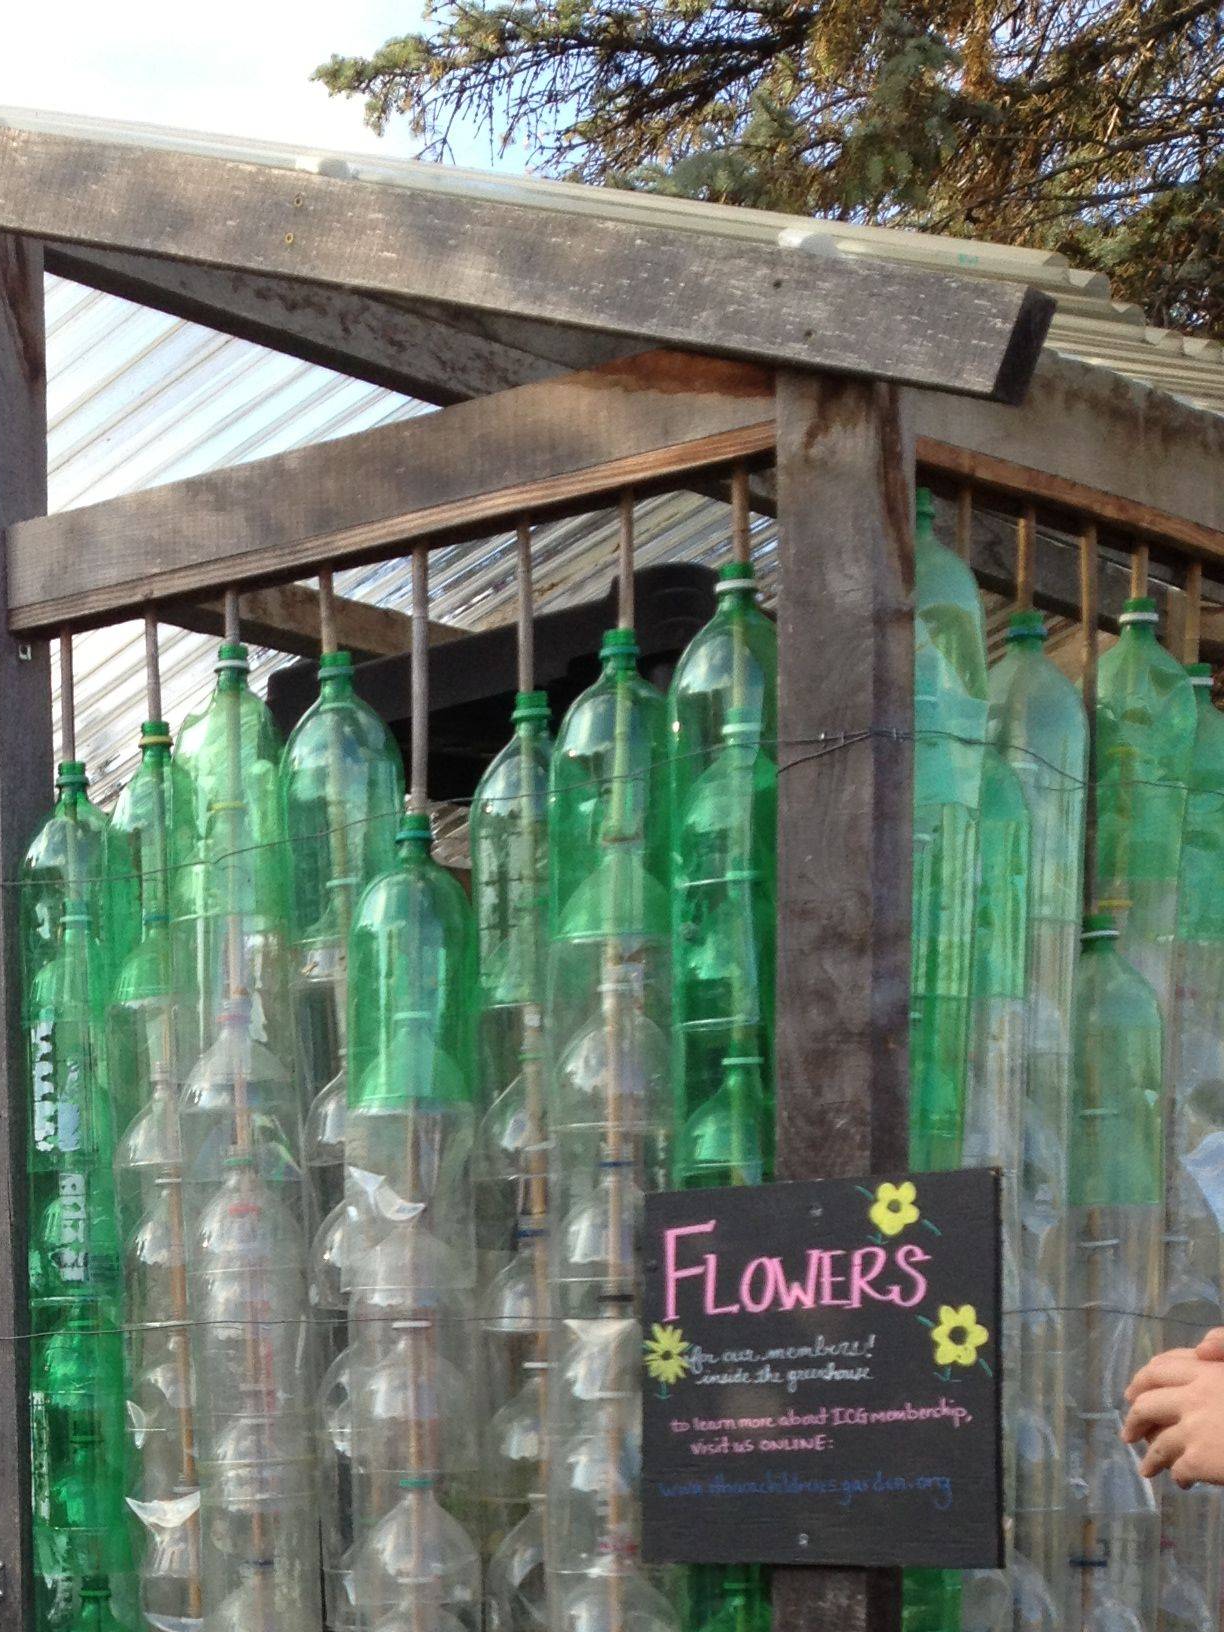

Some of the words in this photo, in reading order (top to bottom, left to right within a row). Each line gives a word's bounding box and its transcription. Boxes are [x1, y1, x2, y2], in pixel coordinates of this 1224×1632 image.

[662, 1219, 932, 1322] FLOWERS
[685, 1345, 720, 1375] for
[722, 1349, 759, 1362] our
[761, 1334, 876, 1361] members!
[695, 1367, 752, 1385] inside
[753, 1363, 784, 1384] the
[786, 1361, 875, 1393] greenhouse
[670, 1418, 690, 1433] to
[692, 1416, 737, 1432] learn
[738, 1416, 776, 1429] more
[777, 1406, 828, 1427] about
[831, 1407, 867, 1425] ICG
[690, 1436, 729, 1456] visit
[732, 1439, 755, 1453] us
